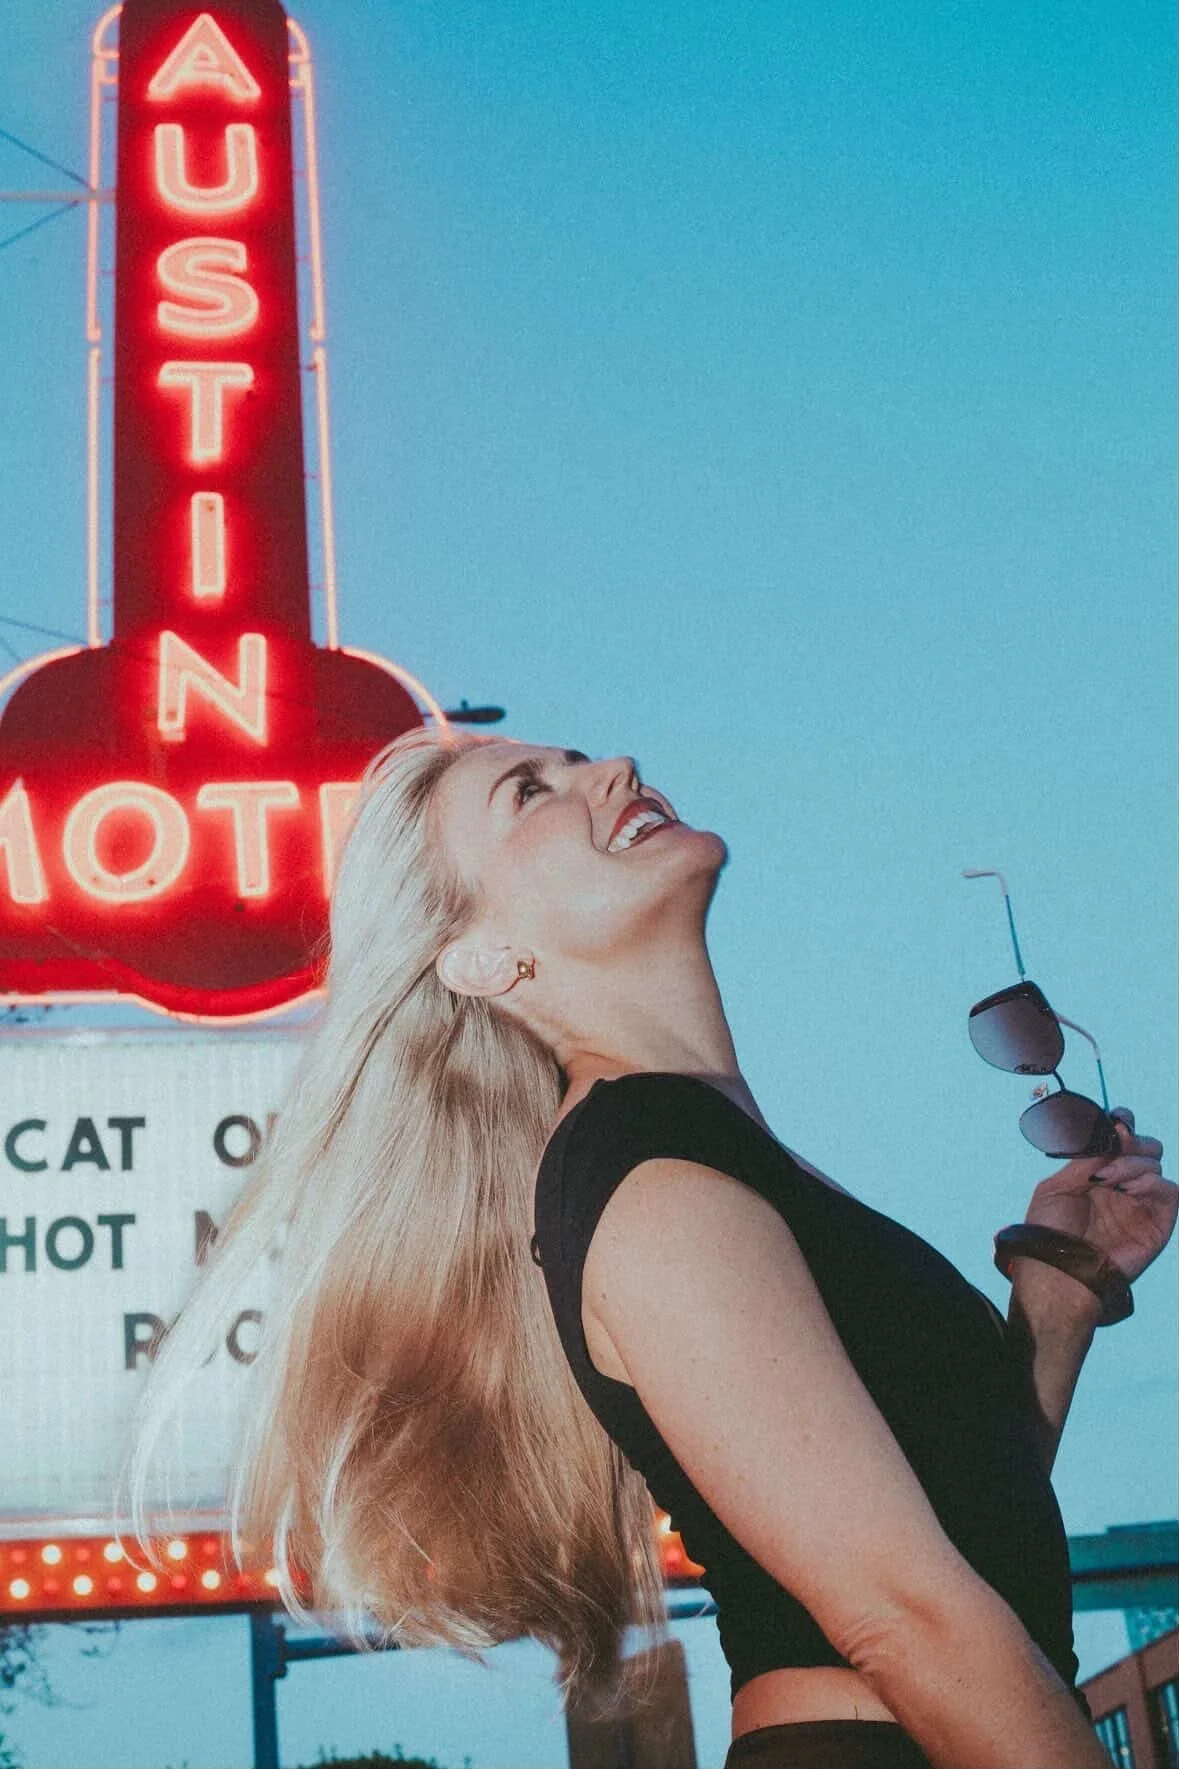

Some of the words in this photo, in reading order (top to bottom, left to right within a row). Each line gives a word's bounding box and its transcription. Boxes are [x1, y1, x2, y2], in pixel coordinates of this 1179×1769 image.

[147, 12, 268, 746] AUSTIN
[4, 1116, 146, 1173] CAT
[213, 1112, 278, 1168] O
[0, 1213, 136, 1273] HOT
